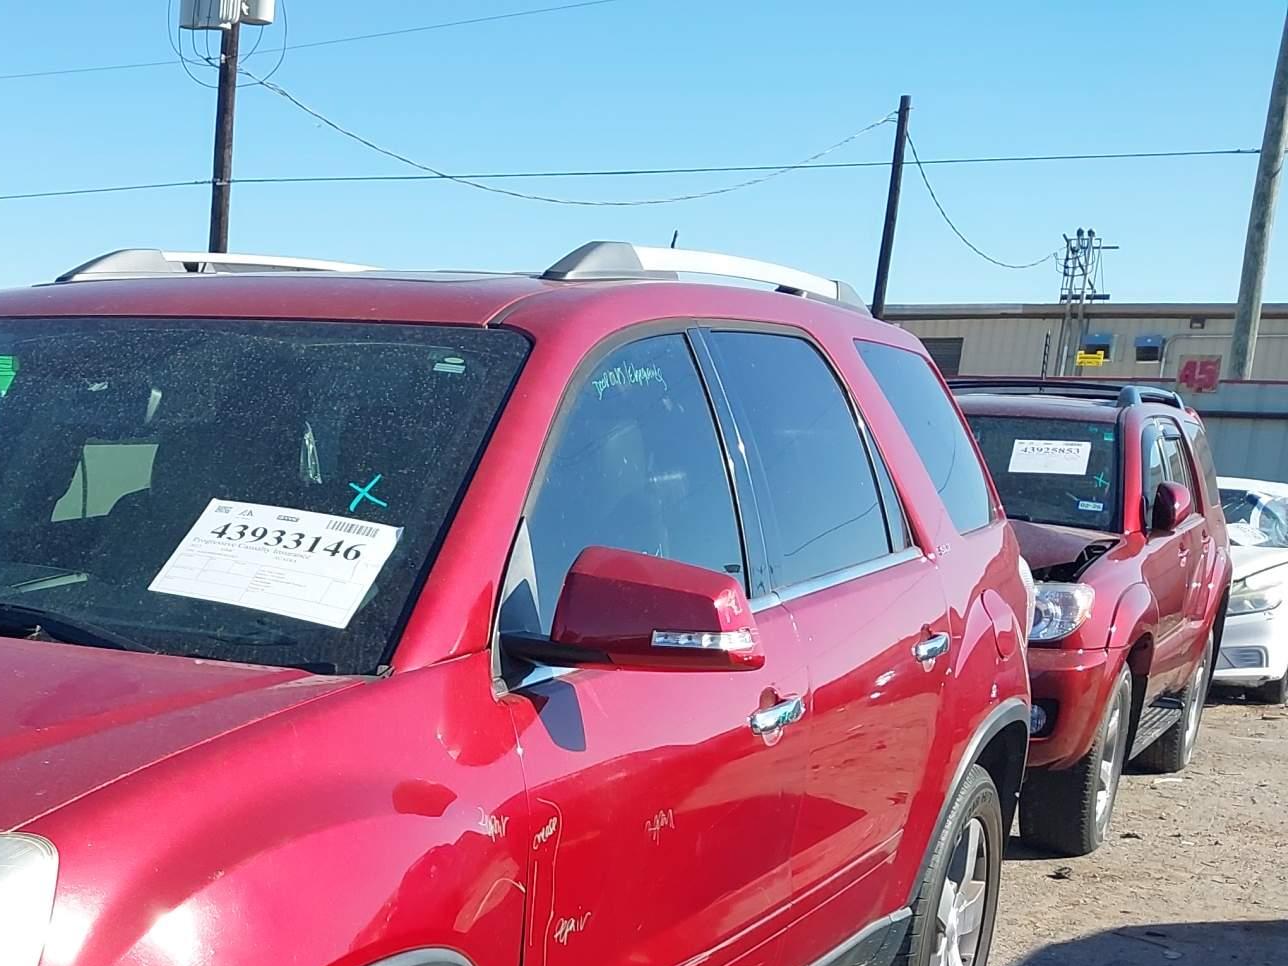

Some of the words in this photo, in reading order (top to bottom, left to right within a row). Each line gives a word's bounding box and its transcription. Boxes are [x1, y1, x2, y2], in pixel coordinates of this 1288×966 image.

[1179, 359, 1221, 389] 45
[1019, 446, 1081, 455] 43925853
[210, 521, 368, 561] 43933146
